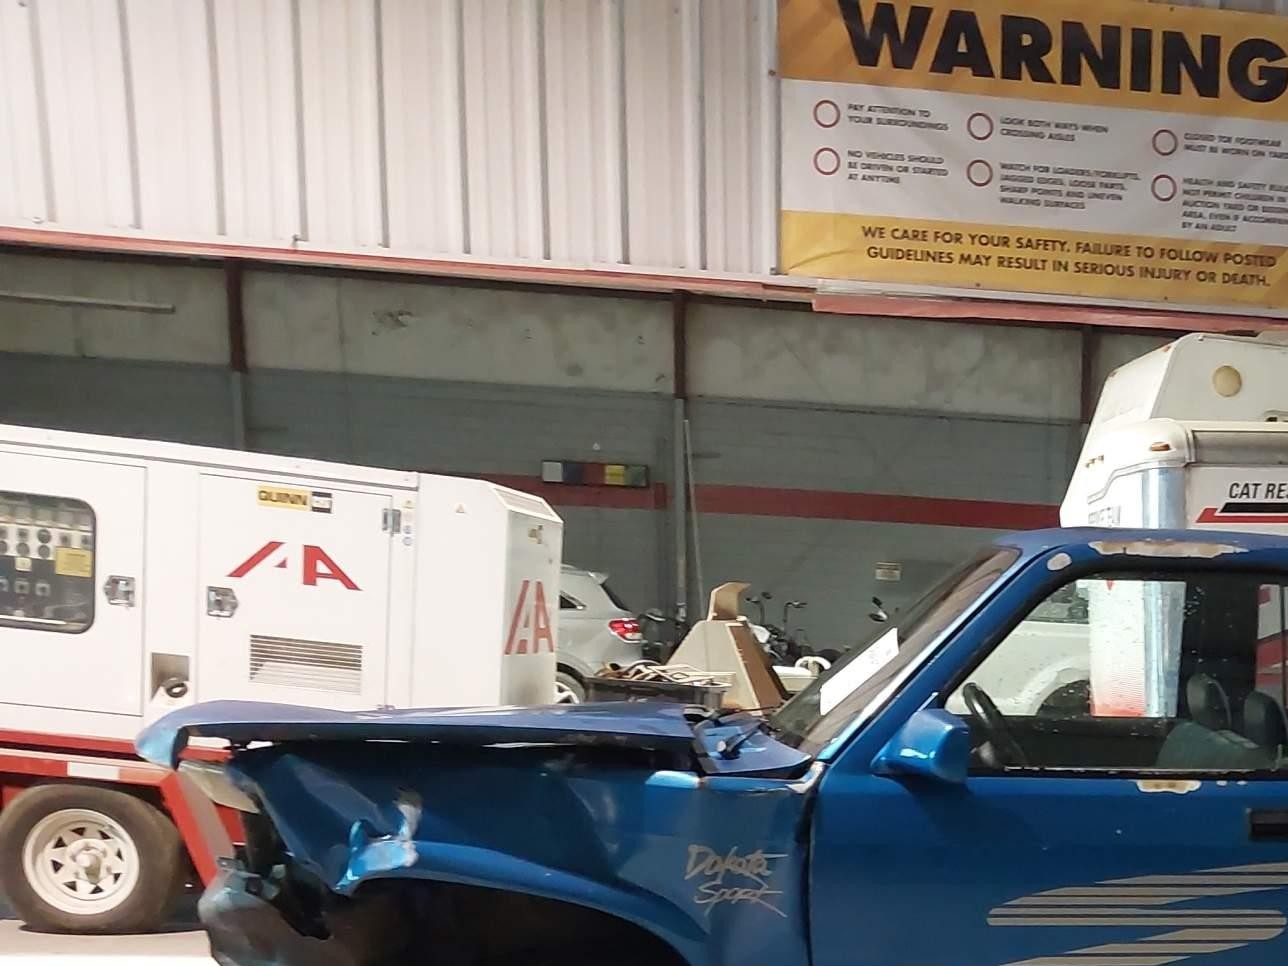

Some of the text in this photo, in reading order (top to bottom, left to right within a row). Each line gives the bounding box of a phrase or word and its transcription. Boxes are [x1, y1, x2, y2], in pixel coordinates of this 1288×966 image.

[848, 116, 872, 124] YOUR
[848, 150, 944, 164] NO VEHICLES SHOULD
[861, 163, 893, 172] DRIVEN
[896, 165, 909, 173] OR
[1033, 165, 1050, 173] FOR
[862, 226, 1277, 268] WE CARE FOR YOUR SAFETY. FAILURE TO FOLLOW POSTED
[867, 246, 1271, 287] GUIDELINES MAY RESULT IN SERIOUS INJURY OR DEATH.
[259, 490, 308, 506] QUINN
[1228, 483, 1263, 500] CAT
[684, 844, 789, 883] Dakota
[694, 881, 788, 918] Sport
